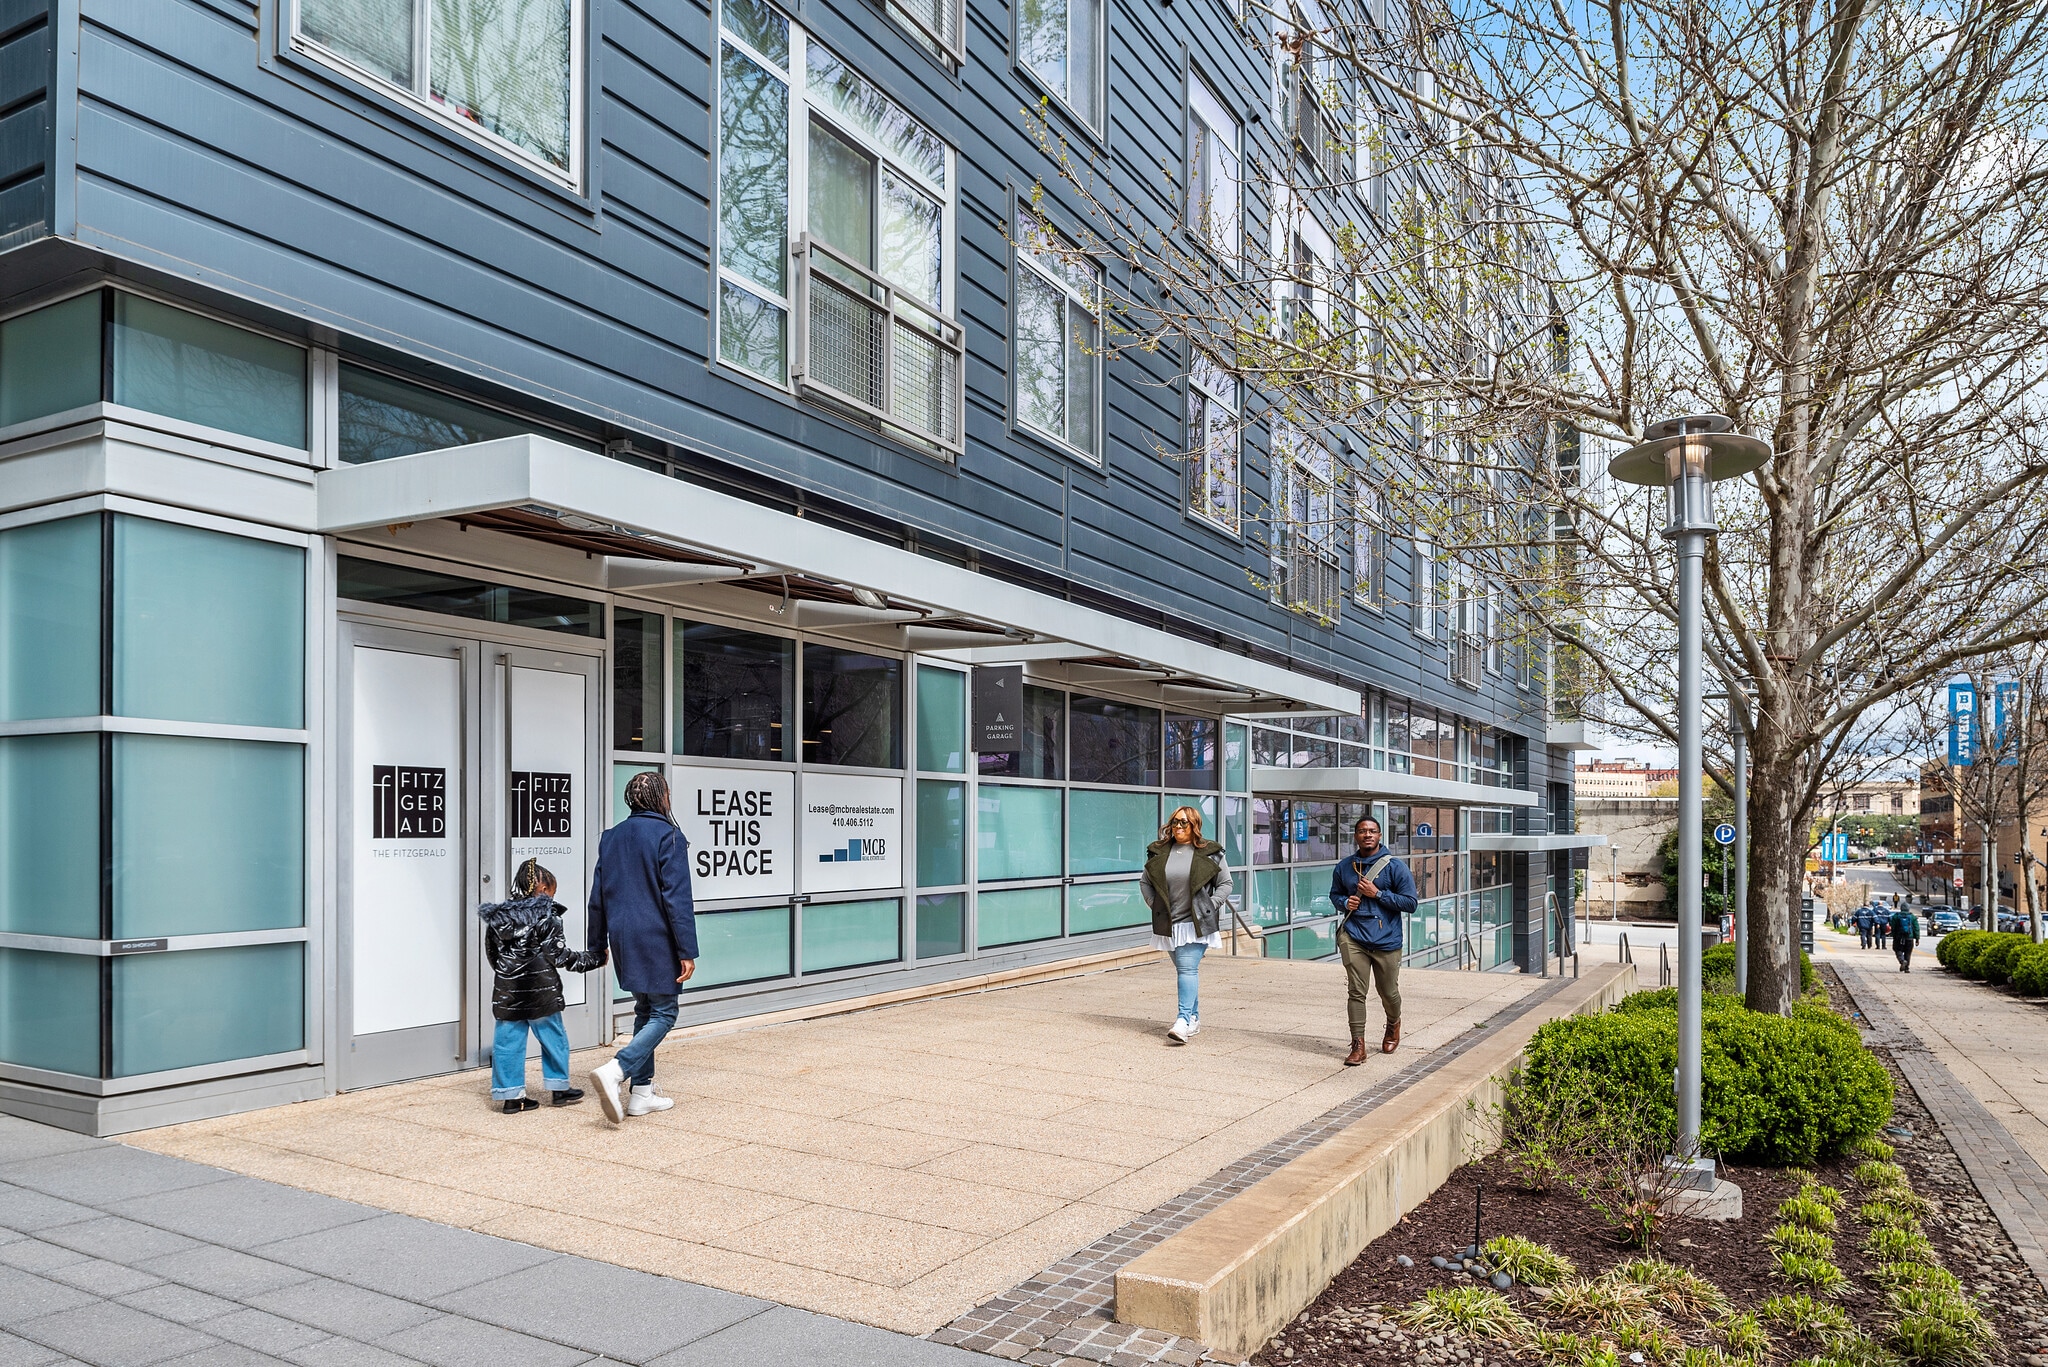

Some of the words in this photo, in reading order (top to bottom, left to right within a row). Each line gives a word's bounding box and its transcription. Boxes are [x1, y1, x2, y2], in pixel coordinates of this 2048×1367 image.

[1958, 714, 1969, 758] UBALT
[401, 772, 443, 789] FITZ
[534, 777, 570, 793] FITZ
[400, 795, 443, 811] GER
[533, 798, 569, 813] GER
[697, 789, 773, 817] LEASE
[808, 803, 895, 816] Lease@mcbrealestate.com
[400, 817, 444, 833] ALD
[533, 818, 570, 833] ALD
[832, 817, 874, 828] 410.406.5112
[709, 820, 761, 846] THIS
[1721, 827, 1732, 840] P
[373, 849, 390, 858] THE
[393, 848, 447, 858] FITZGERALD
[512, 847, 525, 855] THE
[527, 846, 572, 855] FITZGERALD
[862, 838, 886, 855] MCB
[696, 849, 773, 878] SPACE
